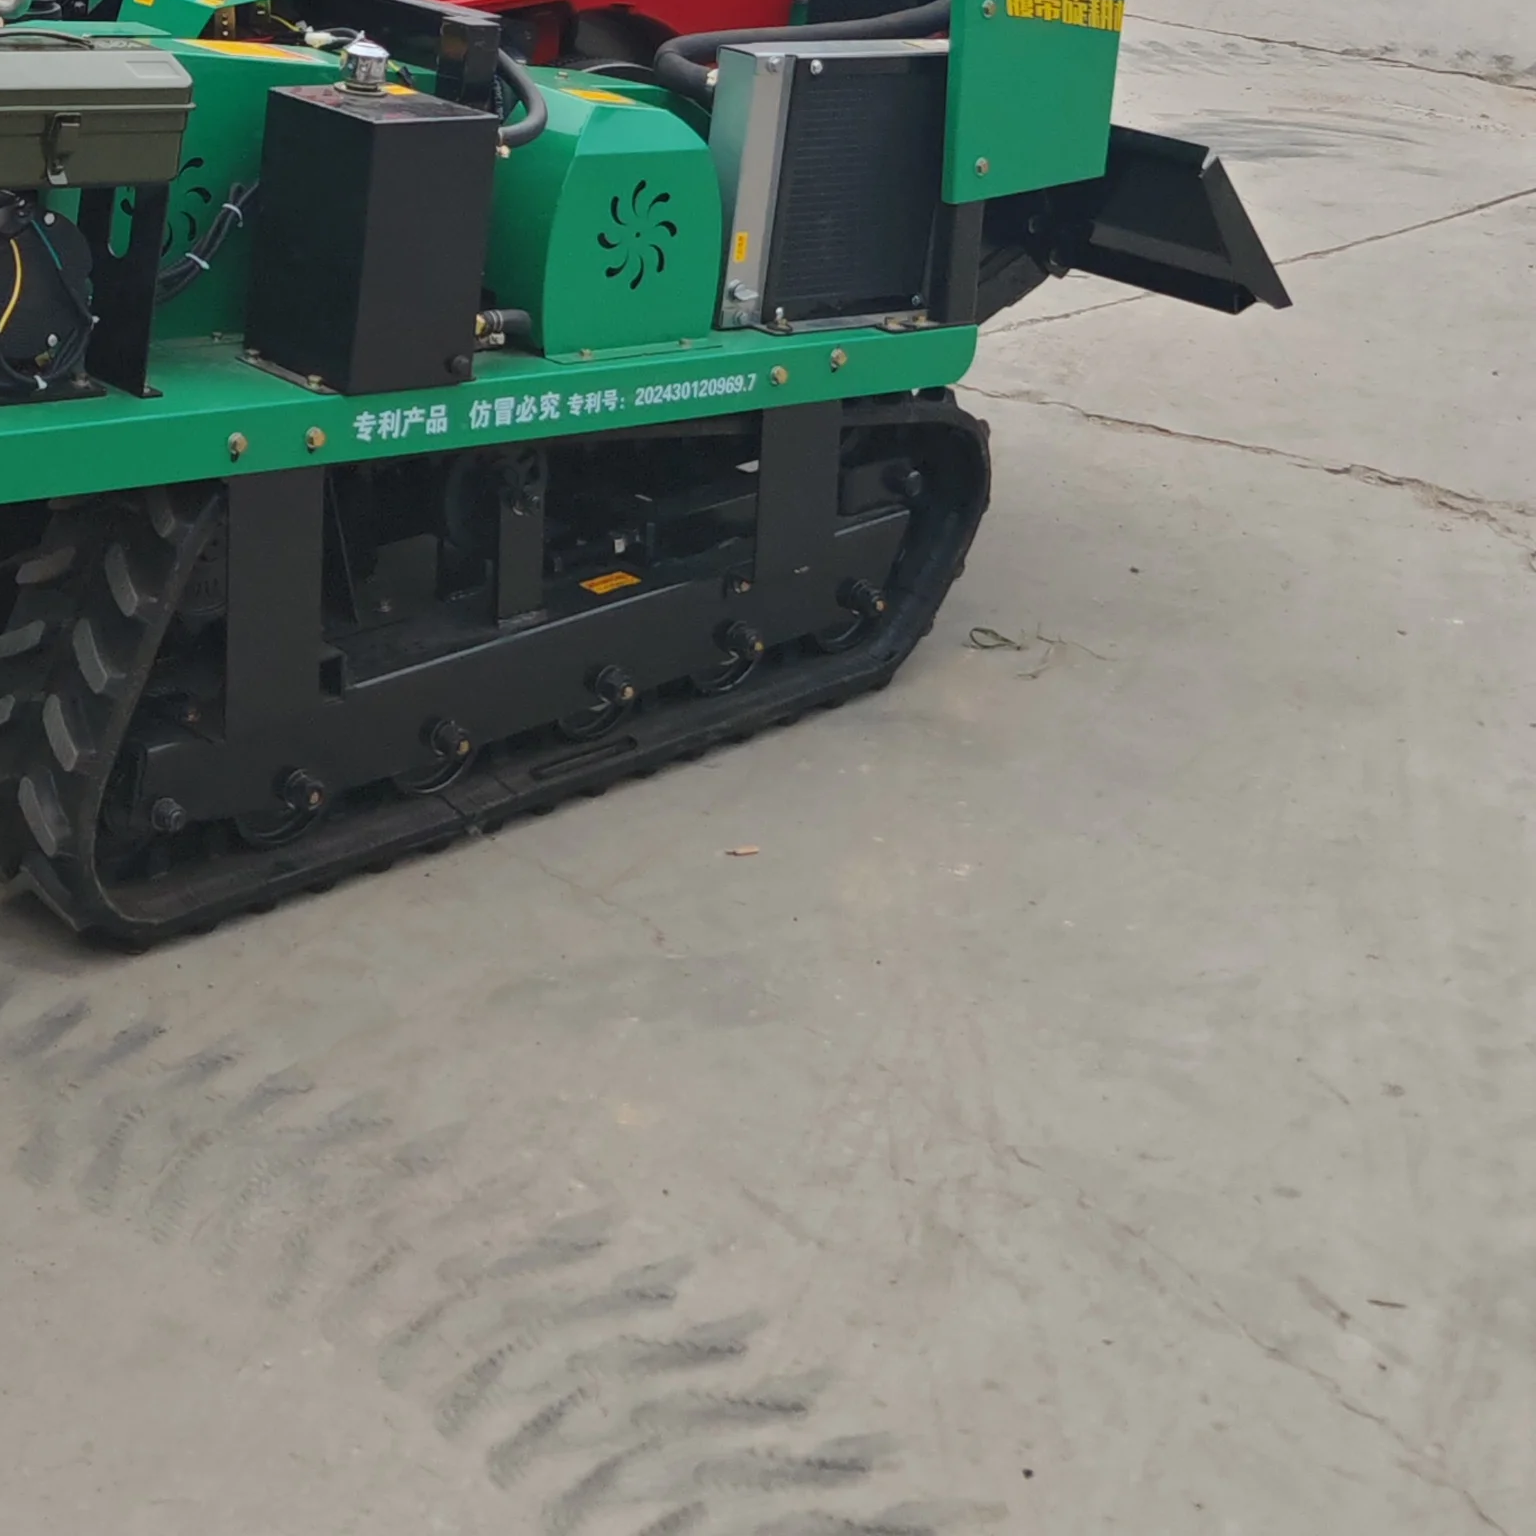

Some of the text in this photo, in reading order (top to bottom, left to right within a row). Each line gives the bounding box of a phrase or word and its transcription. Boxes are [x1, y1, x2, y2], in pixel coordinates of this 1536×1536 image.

[353, 403, 449, 442] 专利产品
[469, 391, 561, 431] 仿冒必究
